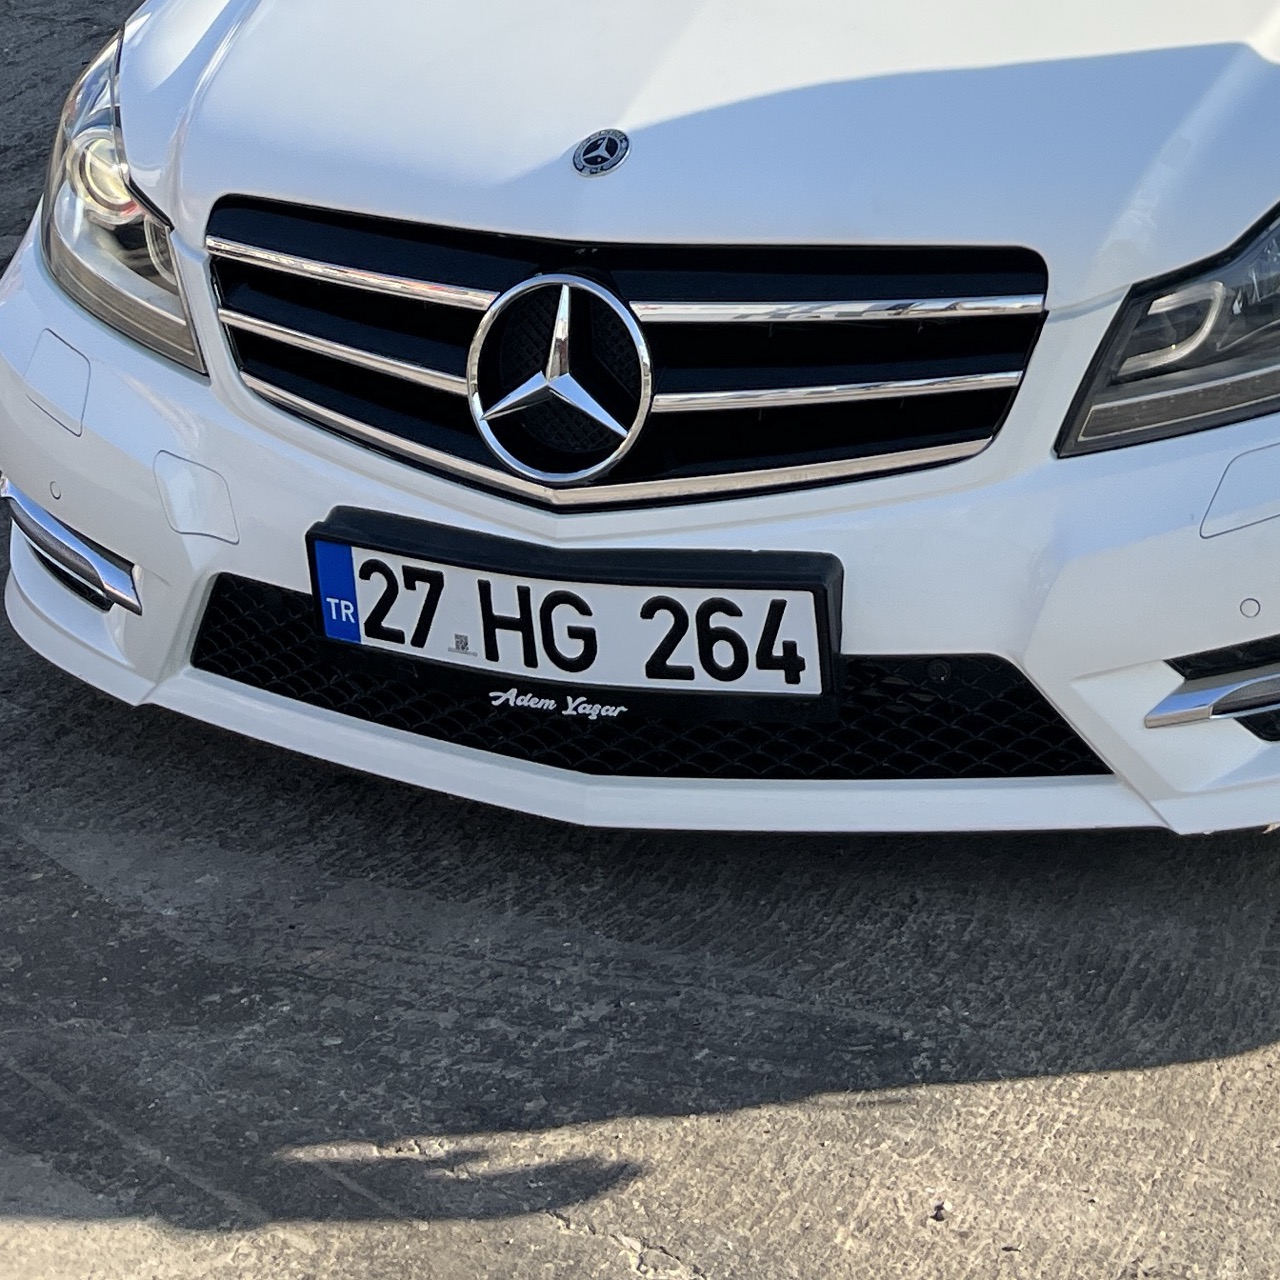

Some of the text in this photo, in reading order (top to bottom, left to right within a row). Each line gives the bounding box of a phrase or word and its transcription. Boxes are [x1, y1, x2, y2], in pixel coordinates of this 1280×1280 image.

[326, 597, 356, 624] TR
[359, 559, 806, 685] 27 HG 264
[489, 687, 557, 711] Adem
